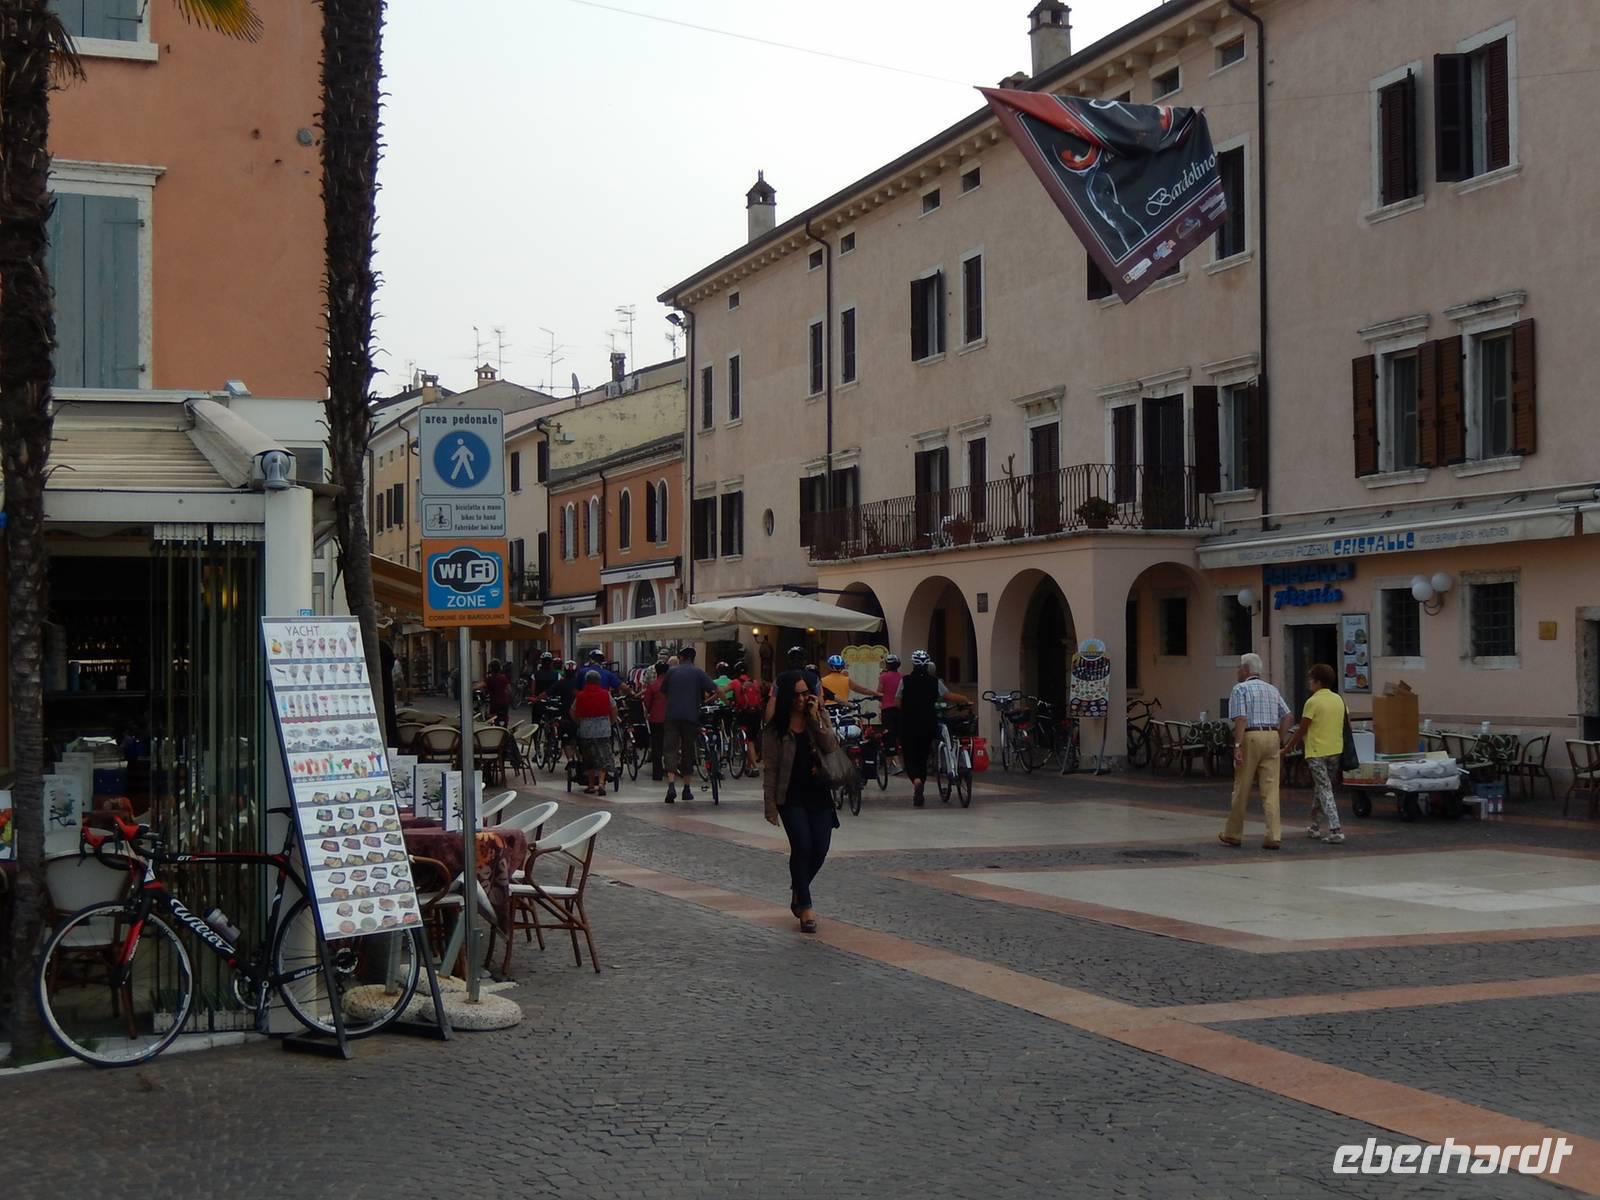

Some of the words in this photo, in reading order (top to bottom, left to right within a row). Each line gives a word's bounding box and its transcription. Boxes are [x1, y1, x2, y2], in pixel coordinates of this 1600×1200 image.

[1144, 152, 1219, 217] Bardolino
[424, 414, 448, 425] area
[452, 412, 499, 427] pedonale
[447, 595, 487, 608] ZONE
[428, 614, 457, 622] COMUNE
[466, 613, 505, 621] BARDOLINO
[284, 625, 320, 637] YACHT
